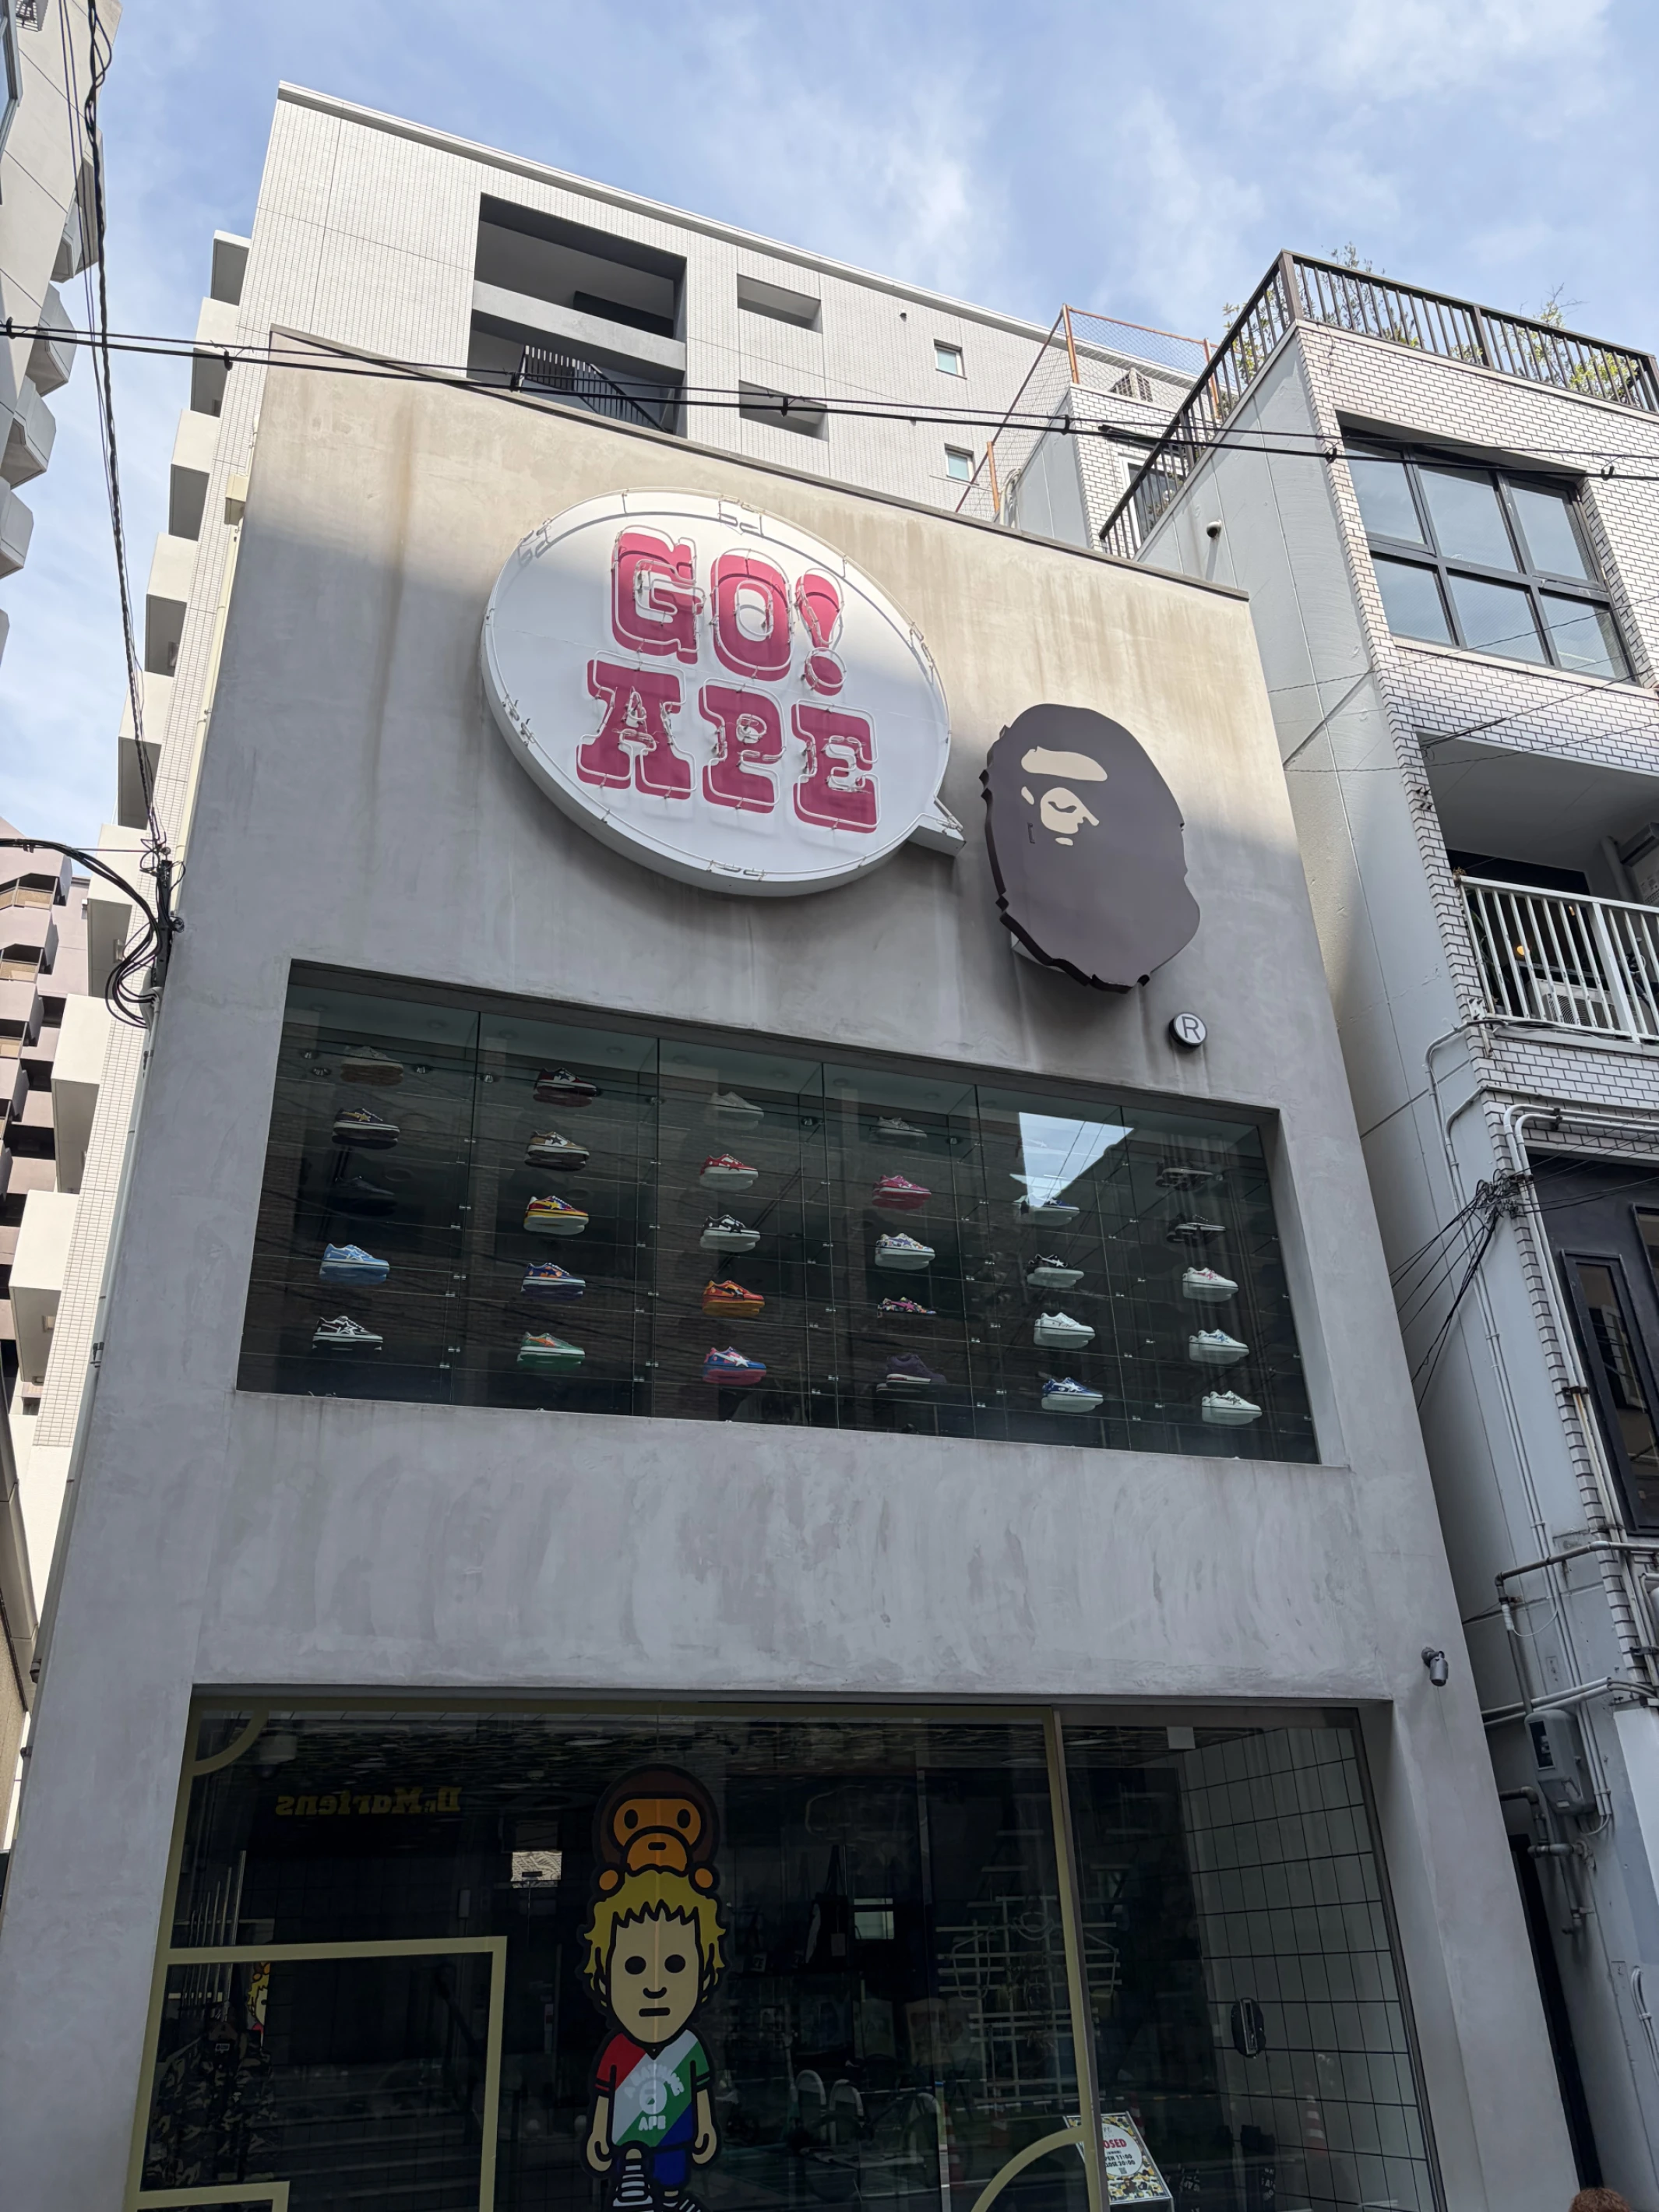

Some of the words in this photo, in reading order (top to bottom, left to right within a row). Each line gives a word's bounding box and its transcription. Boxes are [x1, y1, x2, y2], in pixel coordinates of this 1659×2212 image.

[611, 526, 846, 696] GO!
[576, 650, 880, 833] APE
[1103, 2139, 1126, 2148] OSED
